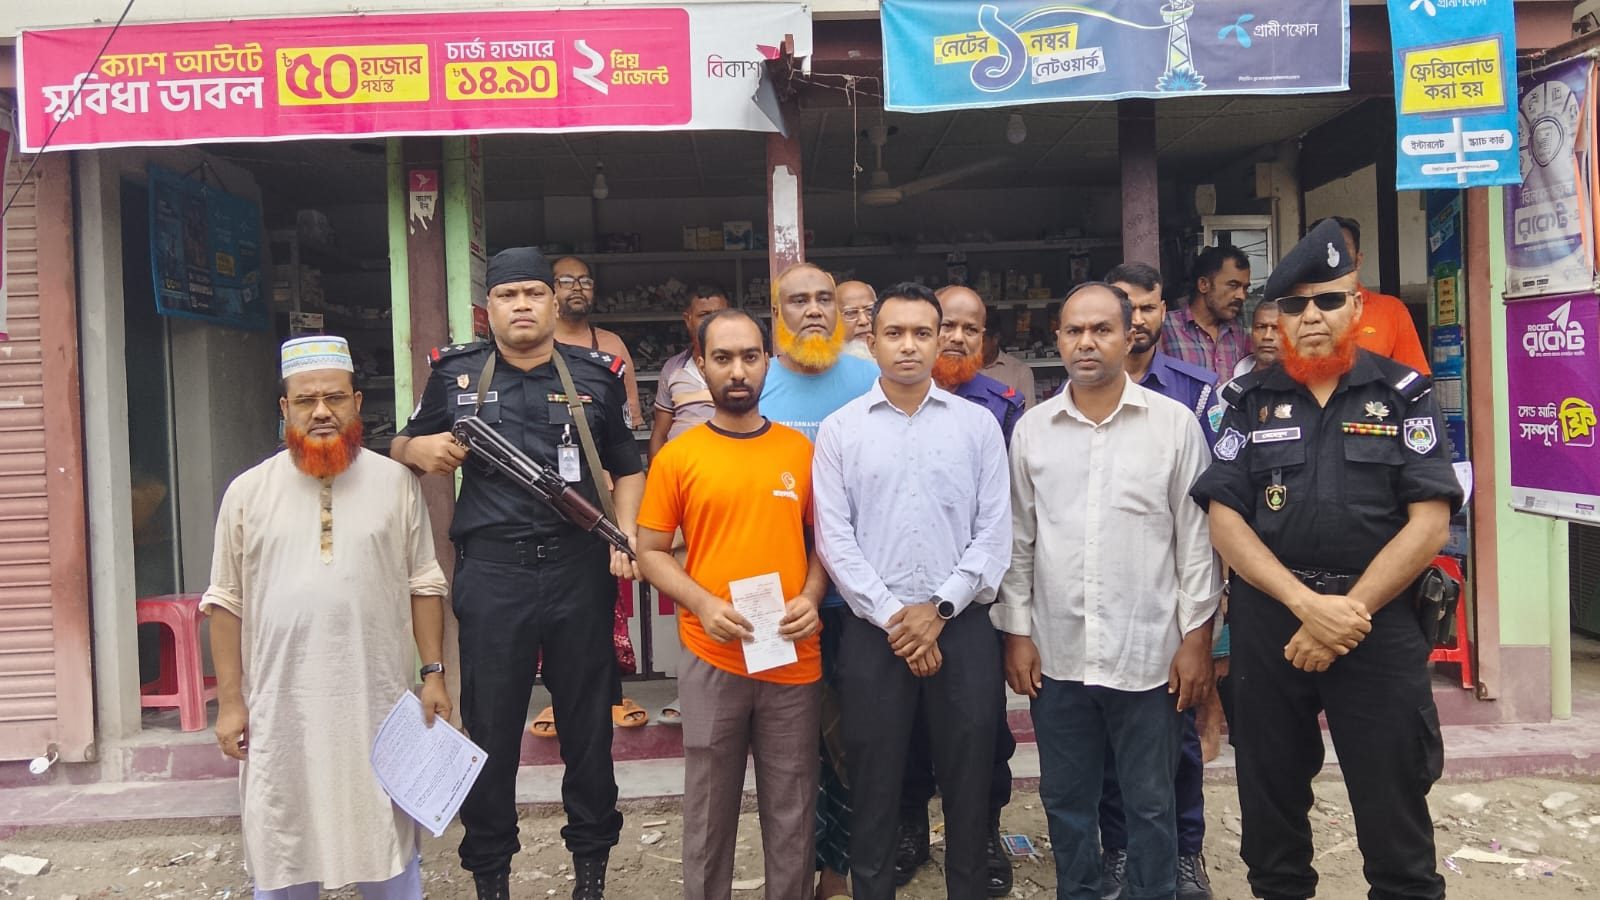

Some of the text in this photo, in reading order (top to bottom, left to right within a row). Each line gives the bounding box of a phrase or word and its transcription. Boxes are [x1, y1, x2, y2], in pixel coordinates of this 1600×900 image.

[1253, 19, 1319, 38] গ্রামীণফোন
[444, 37, 555, 59] চার্জ হাজারে
[941, 34, 991, 58] নেটের
[1030, 30, 1071, 51] নম্বর
[100, 42, 263, 77] ক্যাশ আউটে
[360, 56, 423, 76] হাজার
[573, 39, 609, 96] ২
[610, 49, 640, 69] প্রিয়
[707, 54, 762, 78] বিকাশ
[1035, 51, 1100, 77] নেটওয়ার্ক
[361, 76, 395, 93] পর্যন্ত
[610, 66, 670, 86] এজেন্টে
[42, 72, 264, 122] সুবিধা ডাবল
[1424, 81, 1484, 100] করা হয়
[1527, 323, 1554, 332] ROCKET
[1522, 320, 1586, 358] রকেট
[1538, 402, 1557, 418] মানি
[1519, 420, 1559, 447] সম্পূর্ণ
